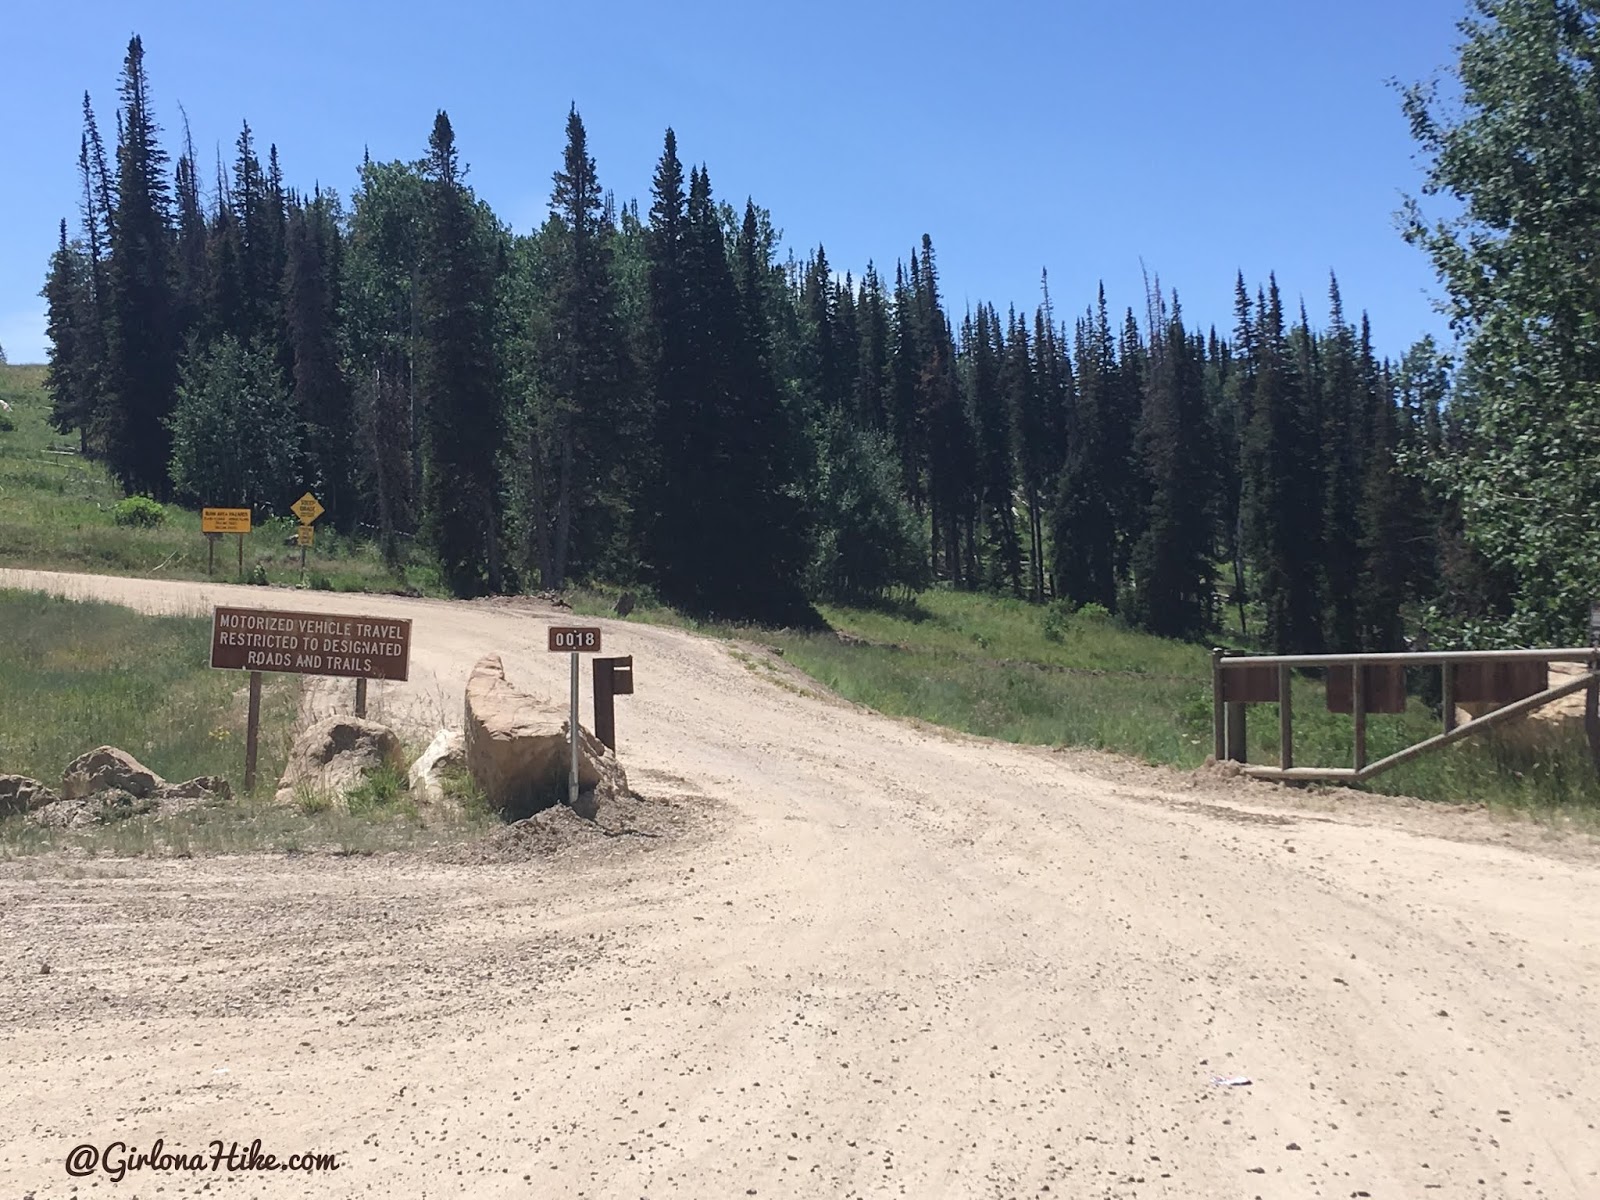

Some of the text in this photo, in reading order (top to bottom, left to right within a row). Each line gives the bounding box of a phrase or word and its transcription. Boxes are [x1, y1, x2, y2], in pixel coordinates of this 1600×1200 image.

[220, 614, 404, 640] MOTORIZED VEHICLE TRAVEL
[219, 631, 402, 657] RESTRICTED TO DESIGNATED
[556, 633, 595, 646] 0018
[247, 650, 372, 673] ROADS AND TRAILS
